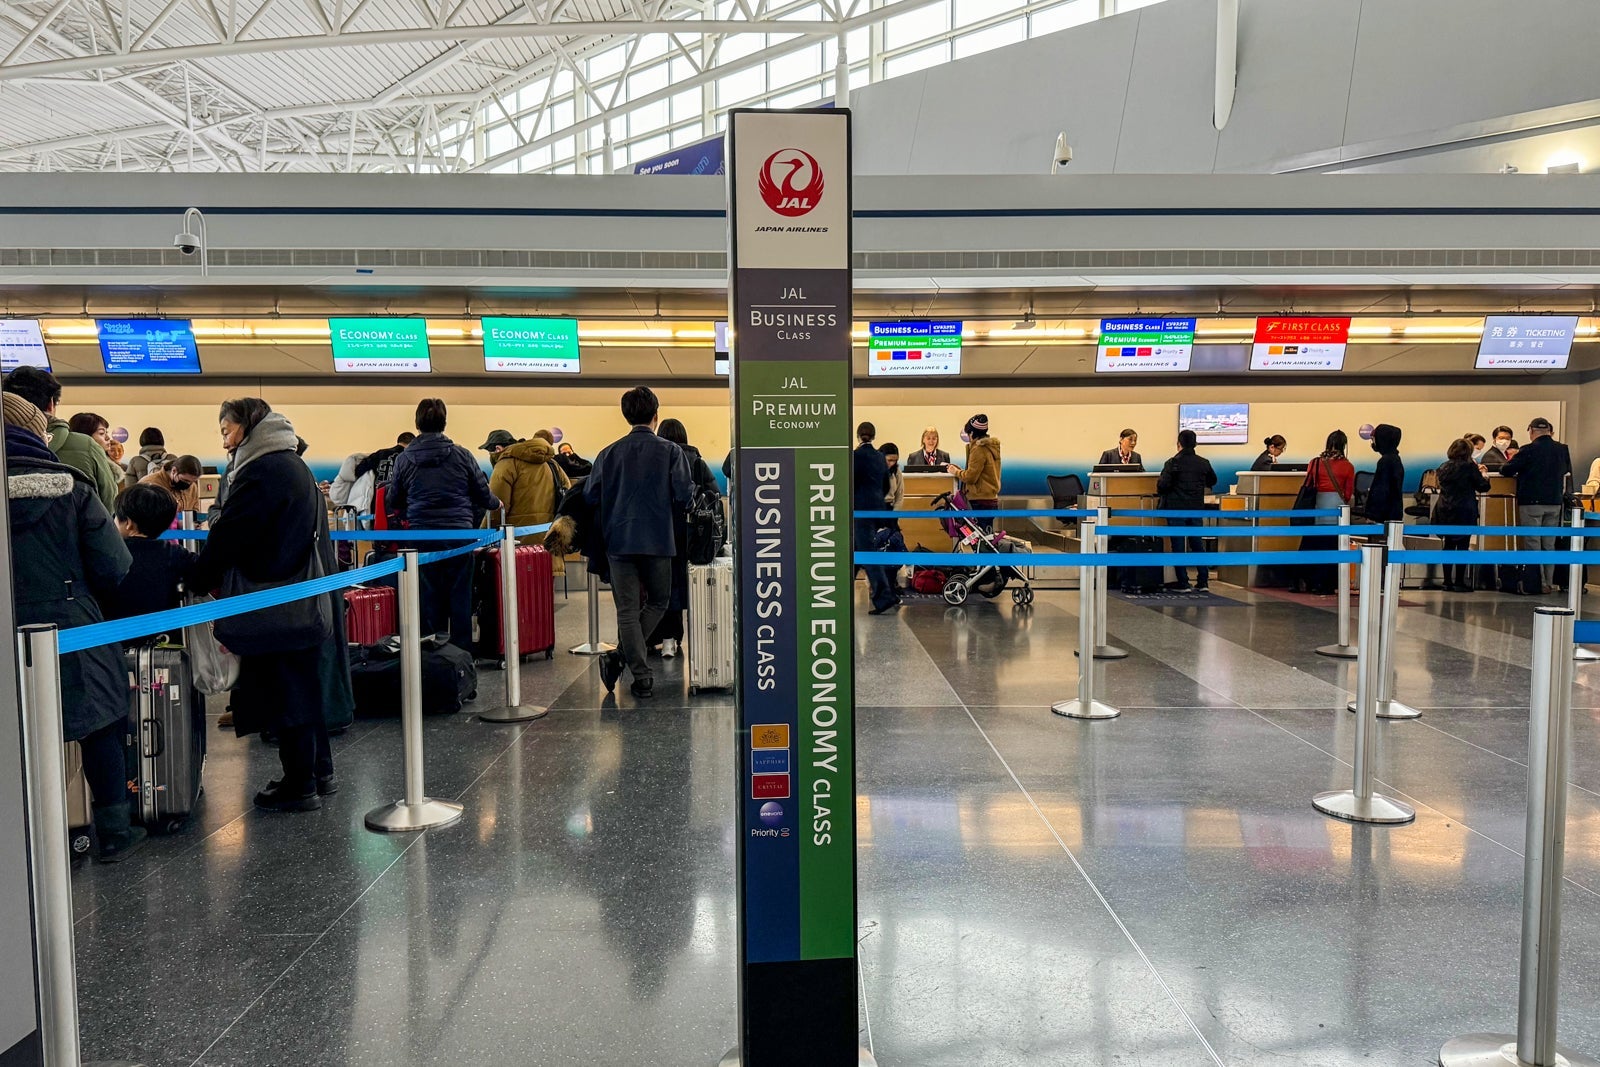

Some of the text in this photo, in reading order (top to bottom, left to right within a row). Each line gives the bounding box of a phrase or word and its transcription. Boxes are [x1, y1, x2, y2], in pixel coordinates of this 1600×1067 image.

[651, 164, 663, 174] you
[664, 159, 679, 168] soon
[776, 197, 811, 208] JAL
[780, 288, 807, 299] JAL
[781, 377, 808, 389] JAL
[754, 462, 782, 691] BUSINESS CLASS
[809, 463, 838, 846] PREMIUM ECONOMY CLASS
[751, 828, 779, 838] Priority
